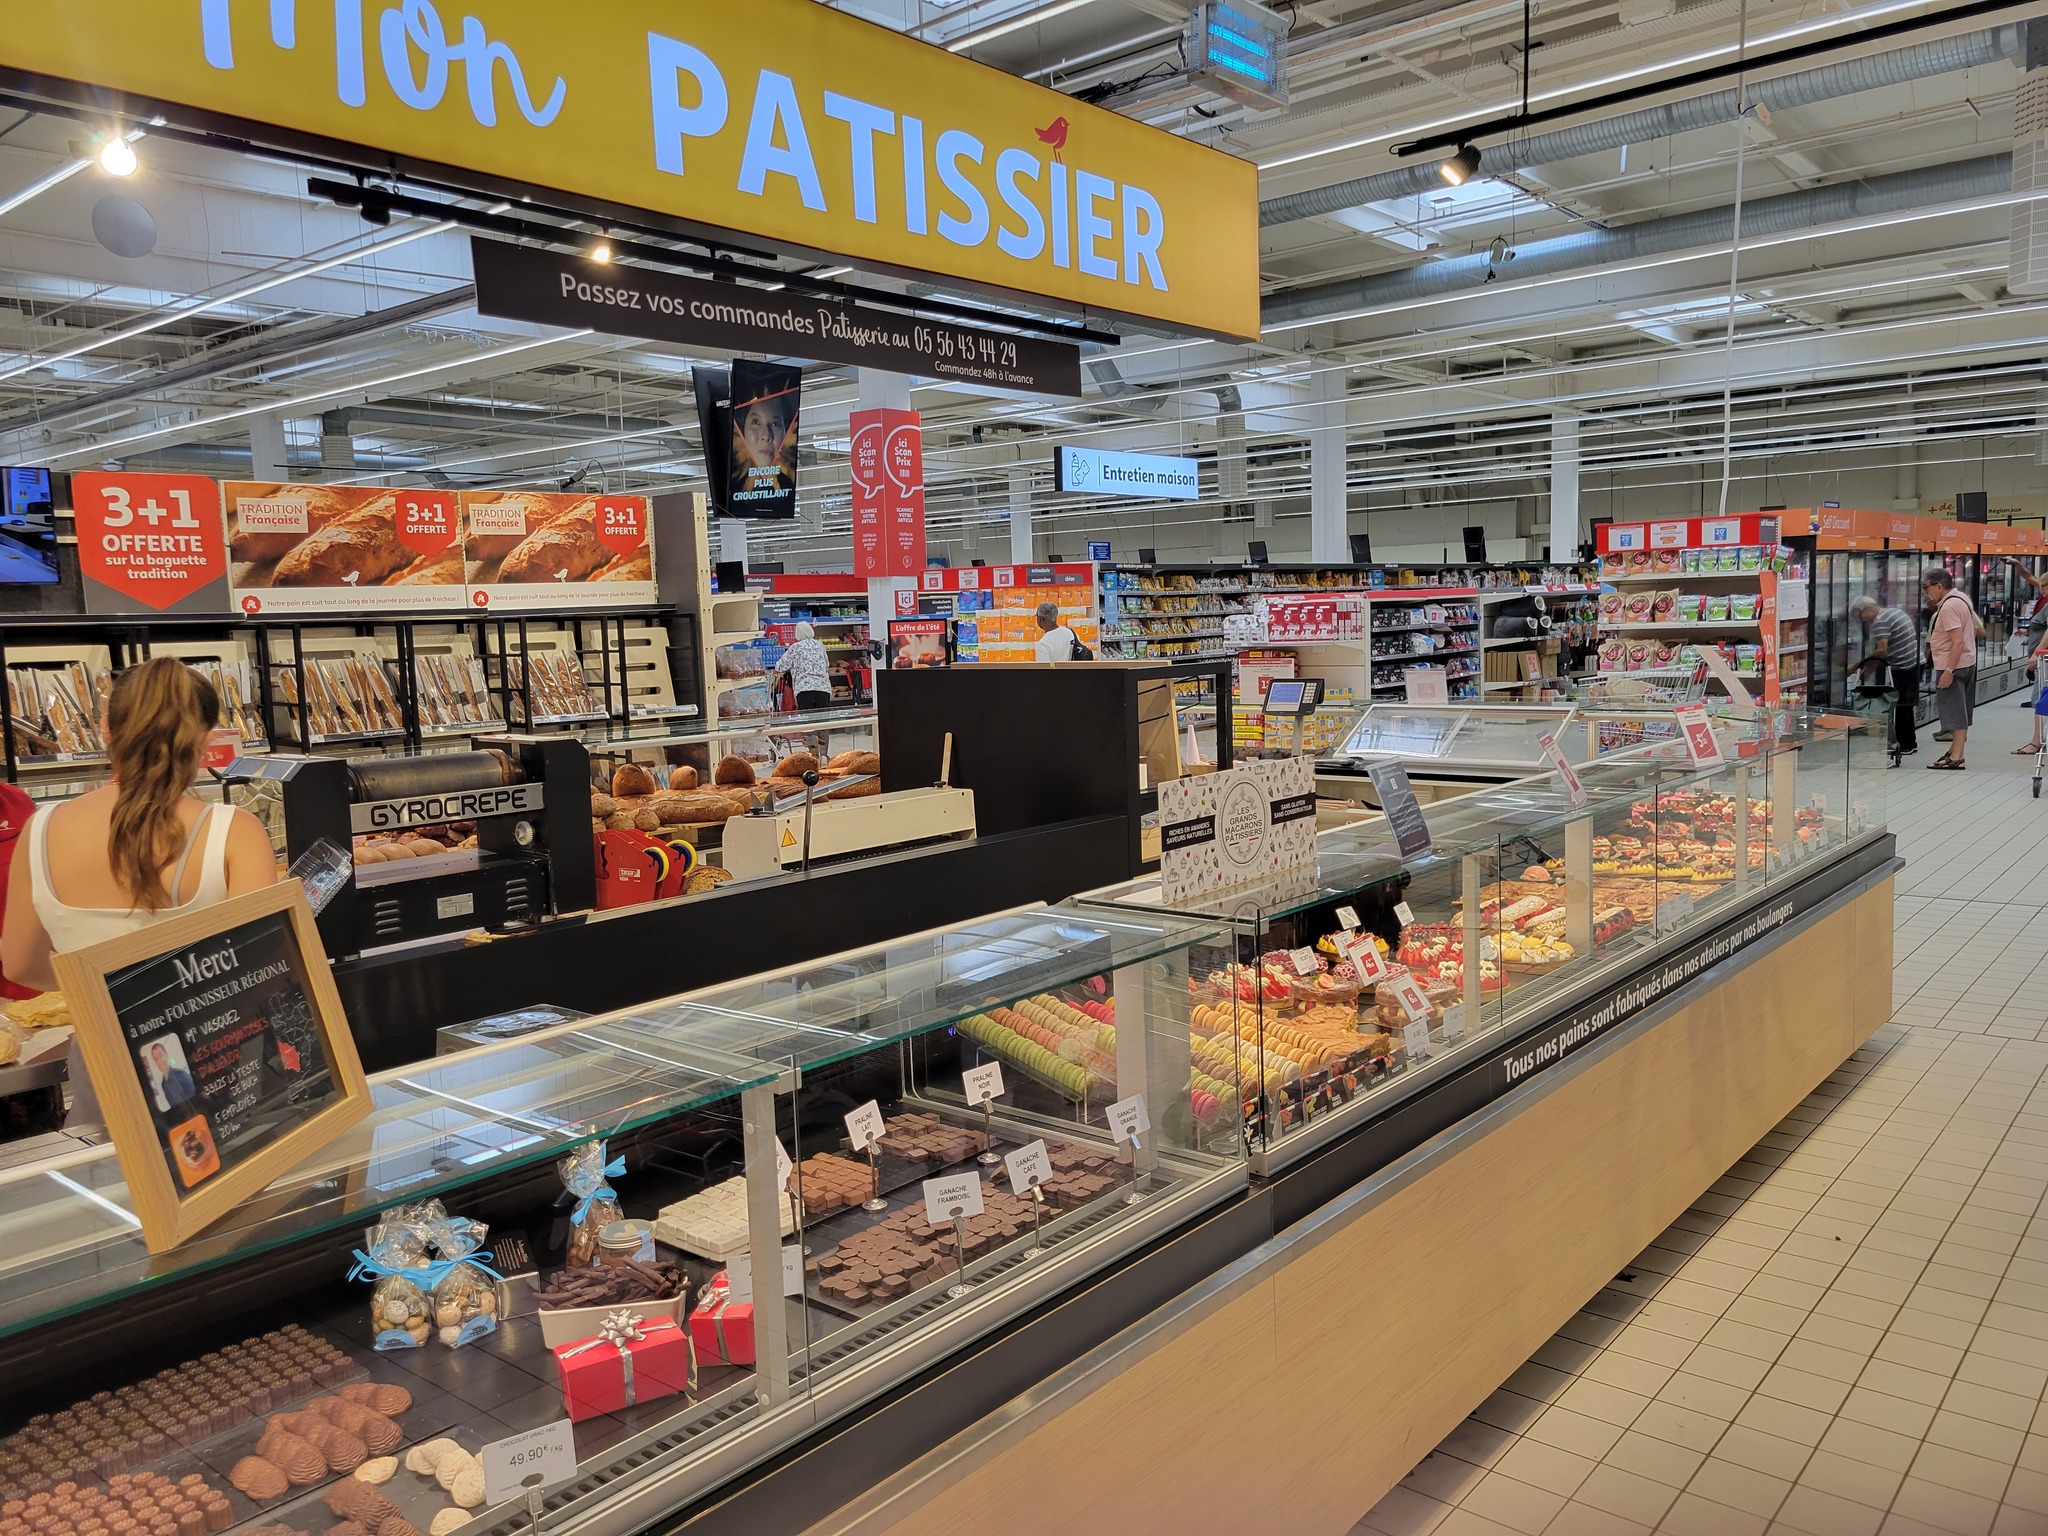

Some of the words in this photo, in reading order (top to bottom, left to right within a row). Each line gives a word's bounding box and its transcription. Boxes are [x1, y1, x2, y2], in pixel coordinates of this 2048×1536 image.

[646, 30, 1170, 293] PATISSIER
[560, 273, 641, 309] Passez
[646, 293, 685, 316] vos
[690, 300, 815, 334] commandes
[817, 308, 890, 347] Patisserie
[893, 332, 910, 349] au
[914, 325, 933, 354] 05
[937, 331, 954, 357] 56
[958, 334, 976, 360] 43
[979, 337, 996, 364] 44
[1000, 341, 1017, 368] 29
[934, 360, 982, 378] Commandez
[983, 367, 998, 380] 48h
[998, 370, 1004, 381] à
[1004, 371, 1034, 385] l'avance
[863, 438, 871, 448] ici
[898, 438, 907, 448] ici
[859, 448, 876, 457] Scan
[894, 446, 912, 456] Scan
[860, 457, 875, 467] Prix
[896, 456, 911, 466] Prix
[748, 466, 781, 477] ENCORE
[1103, 465, 1154, 483] Entretien
[1157, 470, 1195, 486] maison
[754, 478, 774, 488] PLUS
[733, 489, 790, 501] CROUSTILLANT
[100, 487, 199, 528] 3+1
[240, 504, 303, 514] TRADITION
[406, 502, 446, 523] 3+1
[472, 509, 521, 518] TRADITION
[246, 515, 300, 527] Française
[604, 507, 637, 525] 3+1
[1822, 514, 1832, 528] Self
[1832, 517, 1851, 530] Discount
[406, 525, 447, 534] OFFERTE
[476, 518, 519, 530] Française
[605, 527, 638, 535] OFFERTE
[102, 534, 203, 552] OFFERTE
[105, 556, 127, 565] sur
[129, 554, 144, 565] la
[146, 554, 207, 568] baguette
[127, 568, 188, 579] tradition
[346, 598, 361, 606] long
[375, 597, 398, 605] journée
[580, 592, 598, 600] journée
[370, 788, 528, 827] GYROCREPE
[1237, 806, 1250, 815] LES
[1280, 802, 1291, 811] SANS
[1291, 799, 1306, 809] GLUTEN
[1274, 810, 1285, 819] SANS
[1285, 804, 1313, 817] CONSERVATEUR
[1229, 813, 1258, 825] GRANDS
[1168, 826, 1183, 836] RICHES
[1191, 821, 1210, 831] AMANDES
[1225, 819, 1263, 835] MACARONS
[1166, 834, 1187, 845] SAVEURS
[1187, 828, 1213, 841] NATURELLES
[1225, 827, 1263, 843] PÂTISSIERS
[173, 939, 240, 989] Merci
[1503, 1051, 1534, 1083] Tous
[1537, 1037, 1557, 1065] nos
[1559, 1019, 1590, 1057] pains
[1591, 1004, 1615, 1032] sont
[1615, 974, 1661, 1018] fabriqués
[1662, 963, 1683, 990] dans
[1684, 955, 1699, 976] nos
[1700, 938, 1730, 967] ateliers
[1730, 932, 1742, 954] par
[1743, 923, 1756, 941] nos
[1756, 901, 1793, 933] boulangers
[130, 1023, 138, 1038] à
[139, 1015, 166, 1035] notre
[164, 981, 242, 1023] FOURNISSEUR
[241, 959, 291, 992] RÉGIONAL
[200, 1009, 240, 1035] VASQUEZ
[193, 1045, 210, 1063] LES
[211, 1017, 270, 1053] GOURMANDISES
[227, 1074, 236, 1083] LA
[237, 1059, 260, 1077] TESTE
[972, 1072, 994, 1084] PRALINE
[230, 1086, 242, 1096] DE
[241, 1075, 258, 1091] BUCH
[978, 1081, 991, 1090] NOIR
[854, 1111, 873, 1126] PRALINE
[1117, 1106, 1138, 1119] GANACHE
[1120, 1113, 1139, 1125] ORANGE
[220, 1126, 230, 1139] 20
[861, 1123, 872, 1132] LAIT
[1015, 1151, 1040, 1168] GANACHE
[1023, 1163, 1037, 1174] CAFE
[939, 1185, 967, 1196] GANACHE
[500, 1435, 530, 1449] CHOCOLAT
[530, 1429, 545, 1439] VRAC
[555, 1444, 563, 1452] kg
